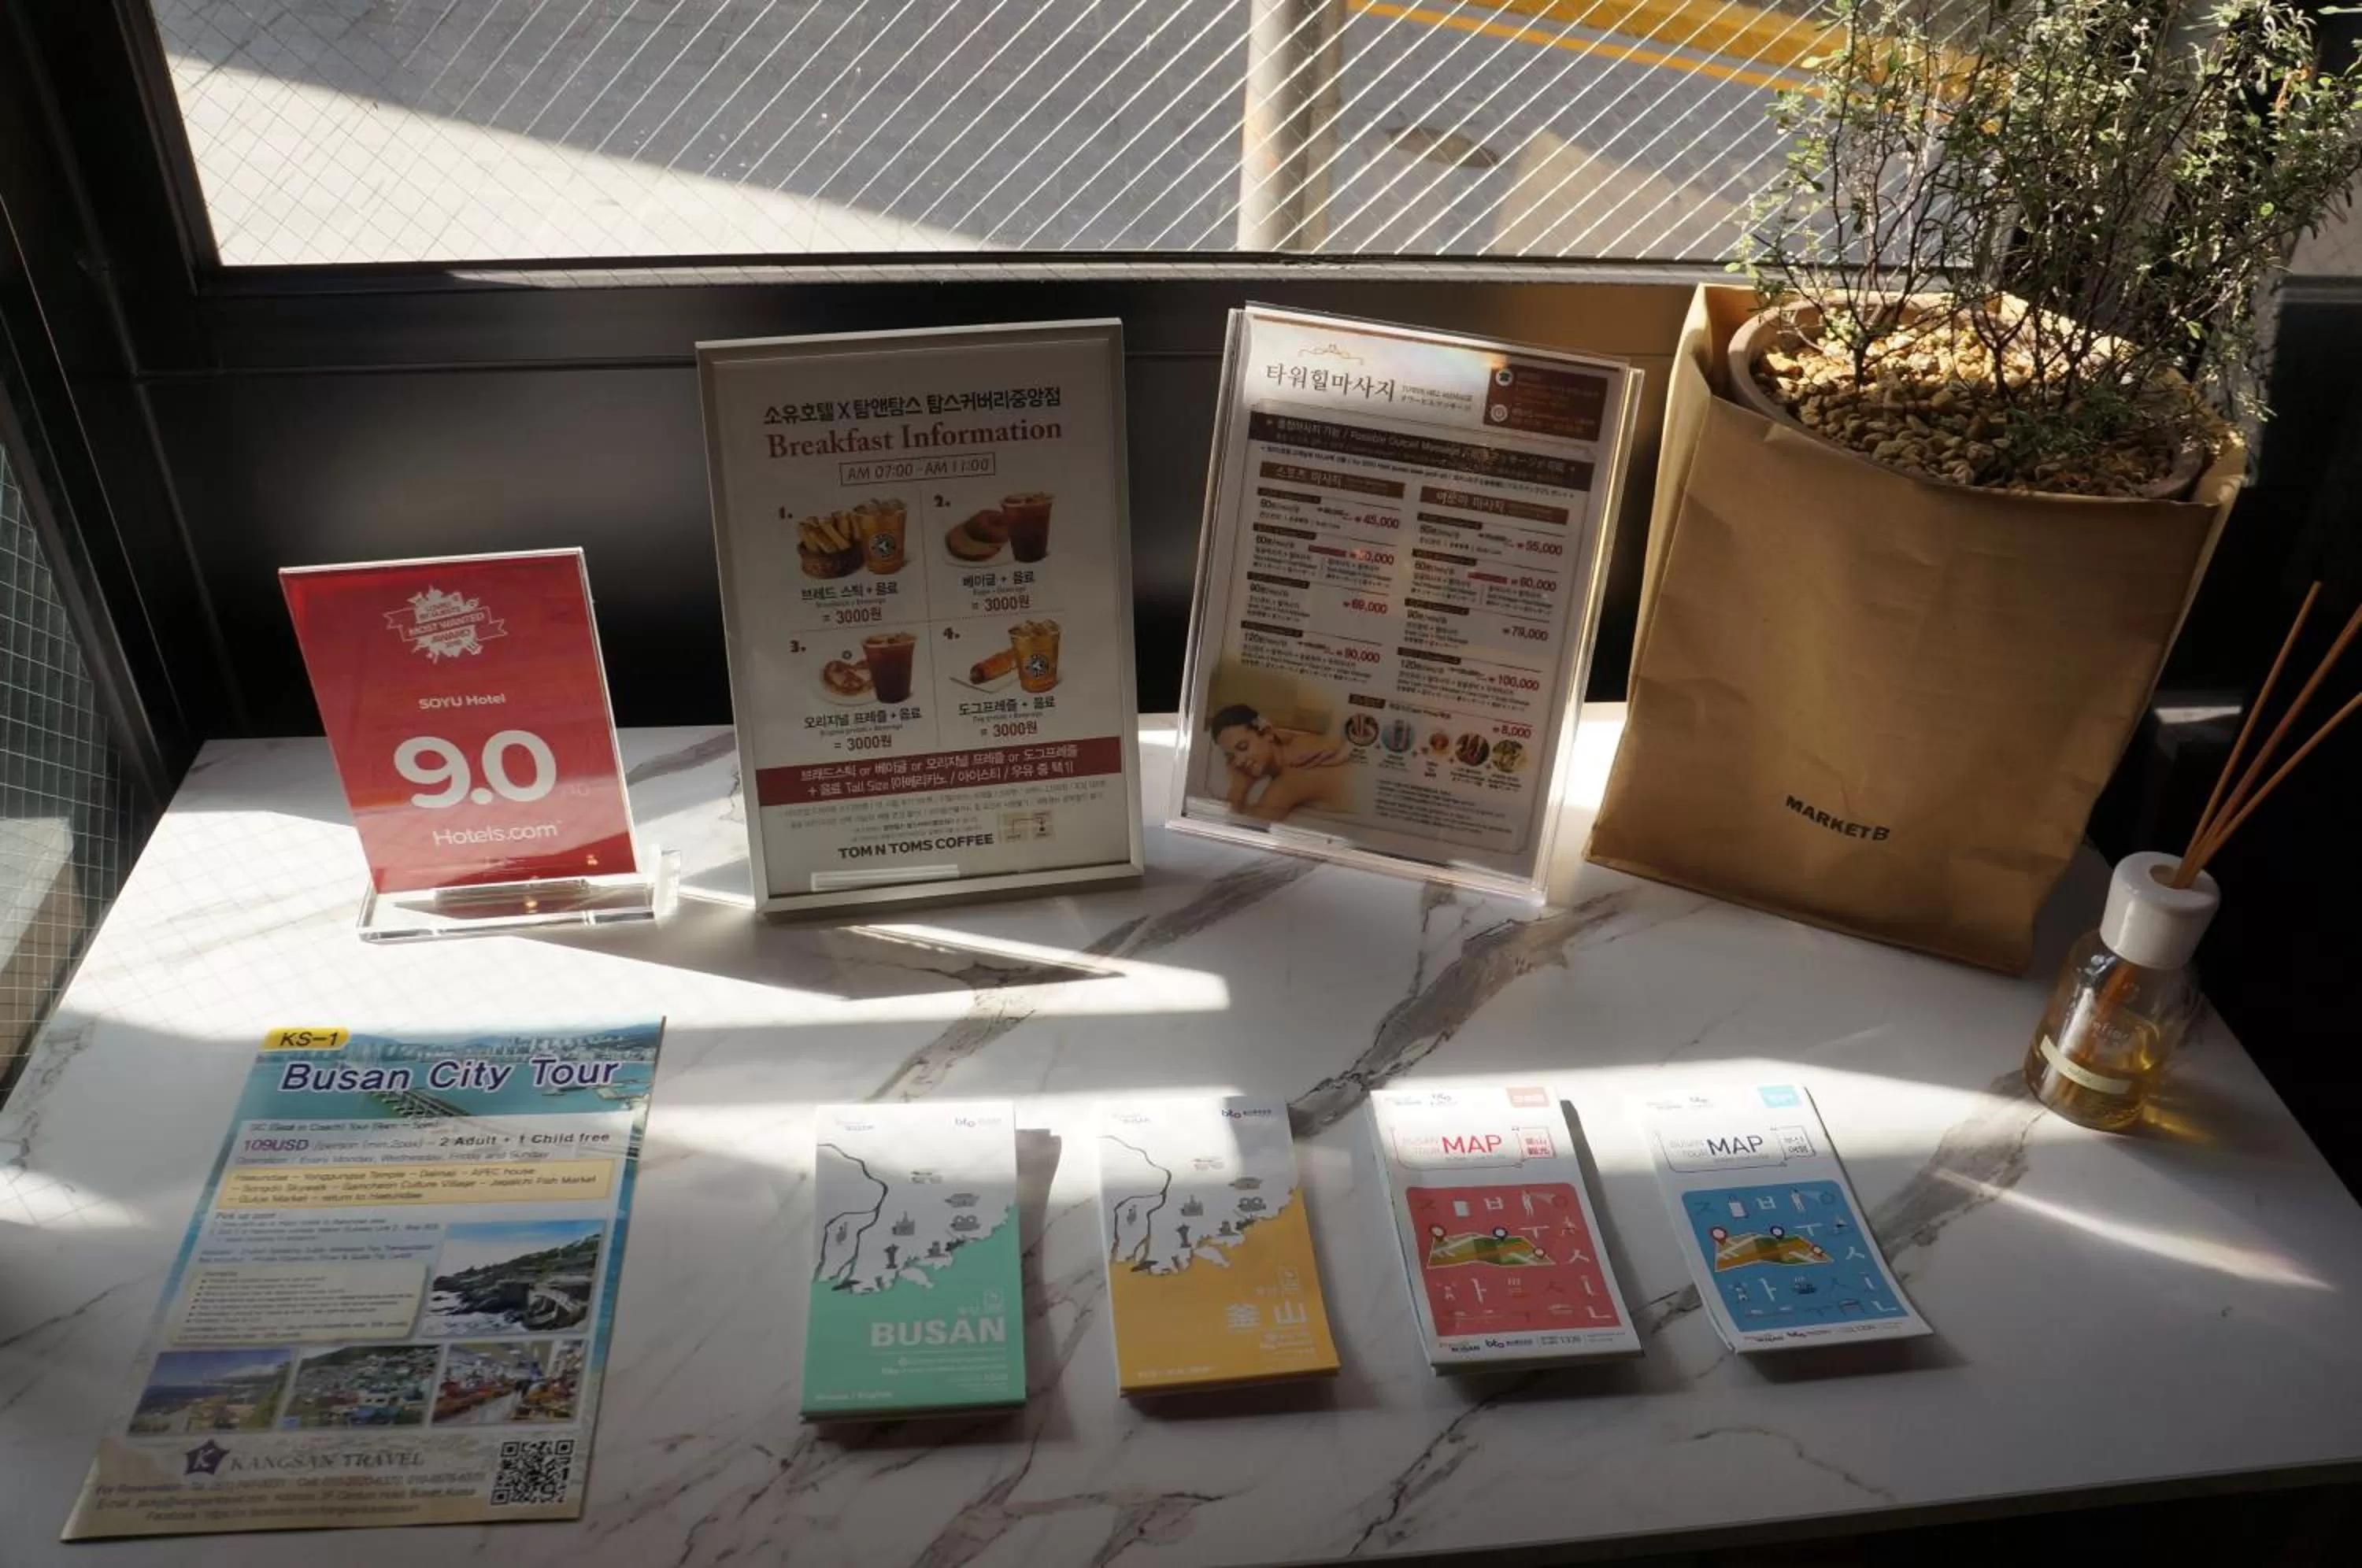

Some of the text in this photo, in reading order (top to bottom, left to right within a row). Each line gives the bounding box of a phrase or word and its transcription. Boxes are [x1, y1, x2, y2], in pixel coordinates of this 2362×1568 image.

[1265, 362, 1396, 401] 타워힐마사지
[763, 402, 835, 425] 소유호텔
[853, 397, 923, 420] 탐앤탐스
[927, 386, 1061, 416] 탐스커버리중앙점
[765, 418, 1062, 459] Breakfast Information
[847, 457, 990, 480] AM 07:00 AM 11:00
[984, 594, 1031, 612] 3000원
[835, 608, 883, 625] 3000원
[419, 693, 506, 710] SOYU Hotel
[992, 722, 1038, 738] 3000원
[846, 734, 892, 752] 3000원
[394, 730, 557, 809] 9.0
[847, 781, 865, 794] Tall
[1785, 794, 1890, 841] MARKETB
[432, 822, 559, 847] Hotels.com
[838, 832, 994, 860] TOM N TOMS COFFEE
[280, 1031, 339, 1047] KS-1
[280, 1056, 620, 1093] Busan City Tour
[244, 1139, 309, 1152] 109USD
[439, 1137, 450, 1147] 2
[454, 1135, 498, 1146] Adult
[531, 1133, 574, 1144] Child
[579, 1132, 611, 1143] free
[1442, 1134, 1502, 1155] MAP
[1706, 1133, 1764, 1156] MAP
[870, 1316, 1007, 1348] BUSAN
[230, 1452, 425, 1472] KANGSAN TRAVEL
